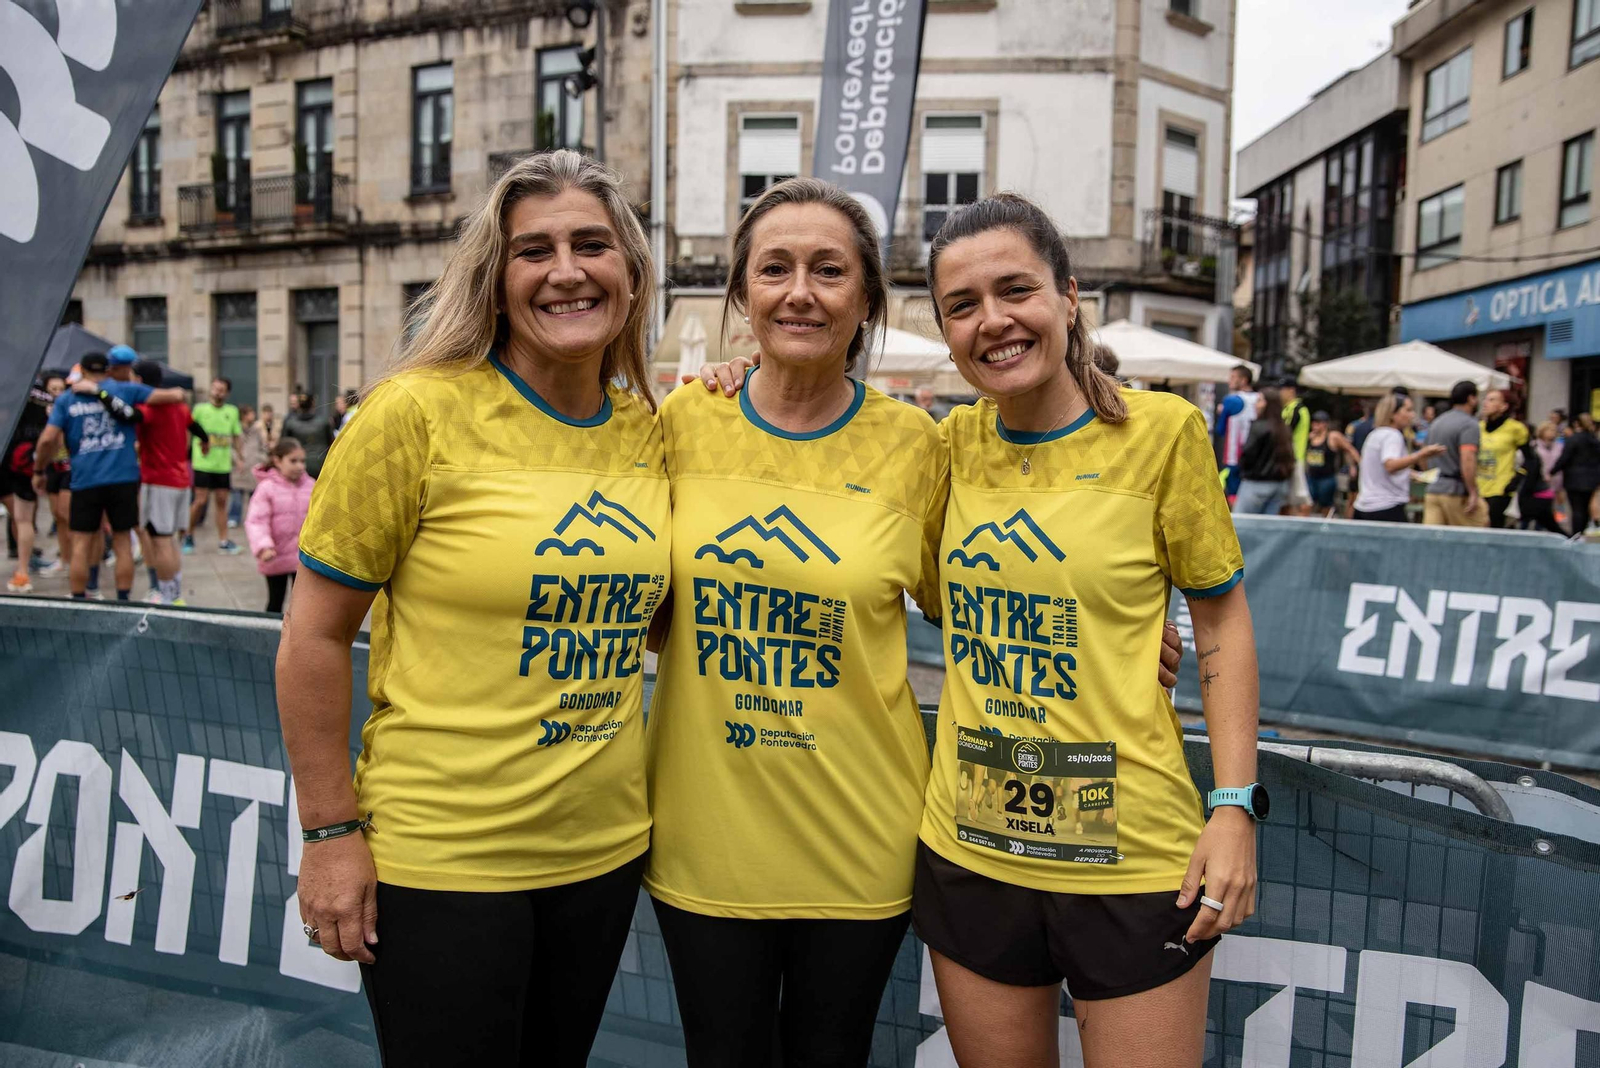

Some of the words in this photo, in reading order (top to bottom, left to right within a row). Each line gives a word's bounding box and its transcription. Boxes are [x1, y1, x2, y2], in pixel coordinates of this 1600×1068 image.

[1490, 278, 1568, 322] OPTICA
[526, 574, 650, 623] ENTRE
[642, 590, 656, 622] TRAIL
[652, 574, 659, 584] &
[693, 577, 820, 638] ENTRE
[821, 598, 834, 608] &
[948, 582, 1050, 646] ENTRE
[1053, 596, 1064, 608] &
[818, 612, 832, 639] TRAIL
[832, 600, 846, 644] RUNNING
[1052, 613, 1064, 646] TRAIL
[1064, 598, 1078, 648] RUNNING
[519, 626, 647, 680] PONTES
[696, 630, 842, 688] PONTES
[1337, 582, 1600, 702] ENTRE
[951, 634, 1078, 700] PONTES
[735, 693, 803, 716] GONDOMAR
[574, 720, 622, 734] Depuación
[760, 728, 815, 741] Deputación
[760, 738, 817, 750] Pontevedra
[1067, 754, 1112, 763] 25/10/2026
[1004, 780, 1054, 818] 29
[1081, 786, 1109, 802] 10K
[1006, 818, 1055, 836] XISELA
[1027, 845, 1056, 853] Deputación
